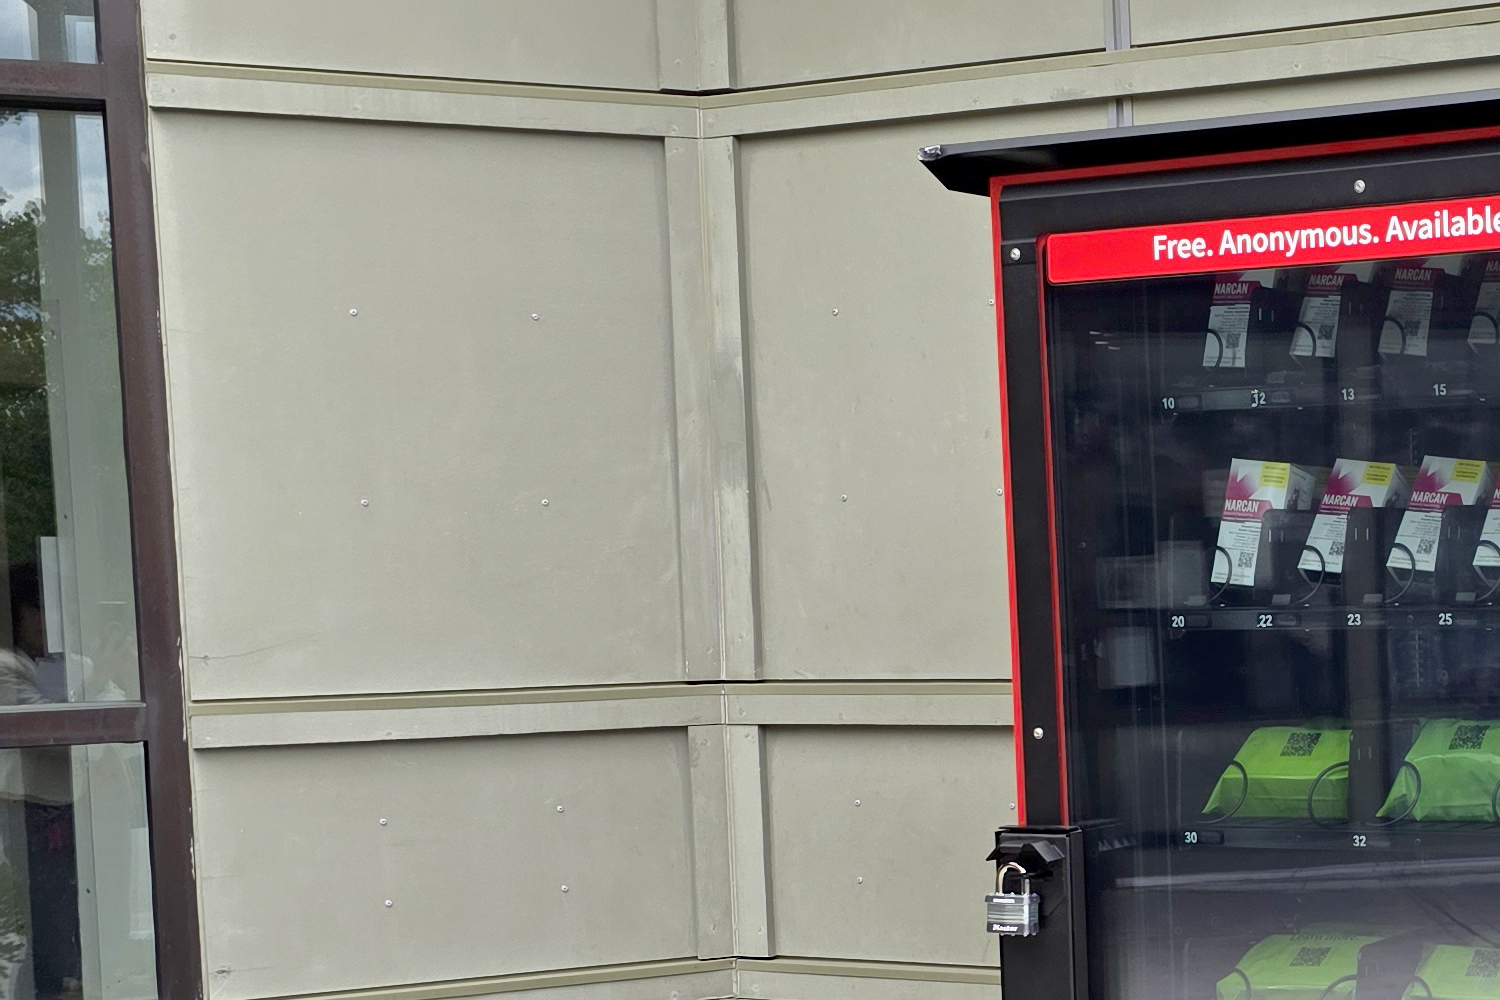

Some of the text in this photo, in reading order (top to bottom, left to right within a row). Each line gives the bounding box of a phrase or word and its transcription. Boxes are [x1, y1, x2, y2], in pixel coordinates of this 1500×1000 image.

[1153, 235, 1213, 261] Free.
[1219, 222, 1379, 257] Anonymous.
[1308, 273, 1345, 287] NARCAN
[1394, 267, 1432, 281] NARCAN
[1214, 281, 1249, 295] NARCAN
[1341, 388, 1355, 401] 13
[1433, 383, 1447, 396] 15
[1162, 397, 1175, 410] 10
[1253, 392, 1267, 405] 12
[1322, 493, 1359, 508] NARCAN
[1410, 491, 1448, 505] NARCAN
[1225, 498, 1260, 513] NARCAN
[1171, 616, 1185, 628] 20
[1259, 614, 1273, 627] 22
[1347, 614, 1361, 626] 23
[1438, 613, 1452, 625] 25
[1184, 831, 1197, 843] 30
[1353, 835, 1366, 847] 32
